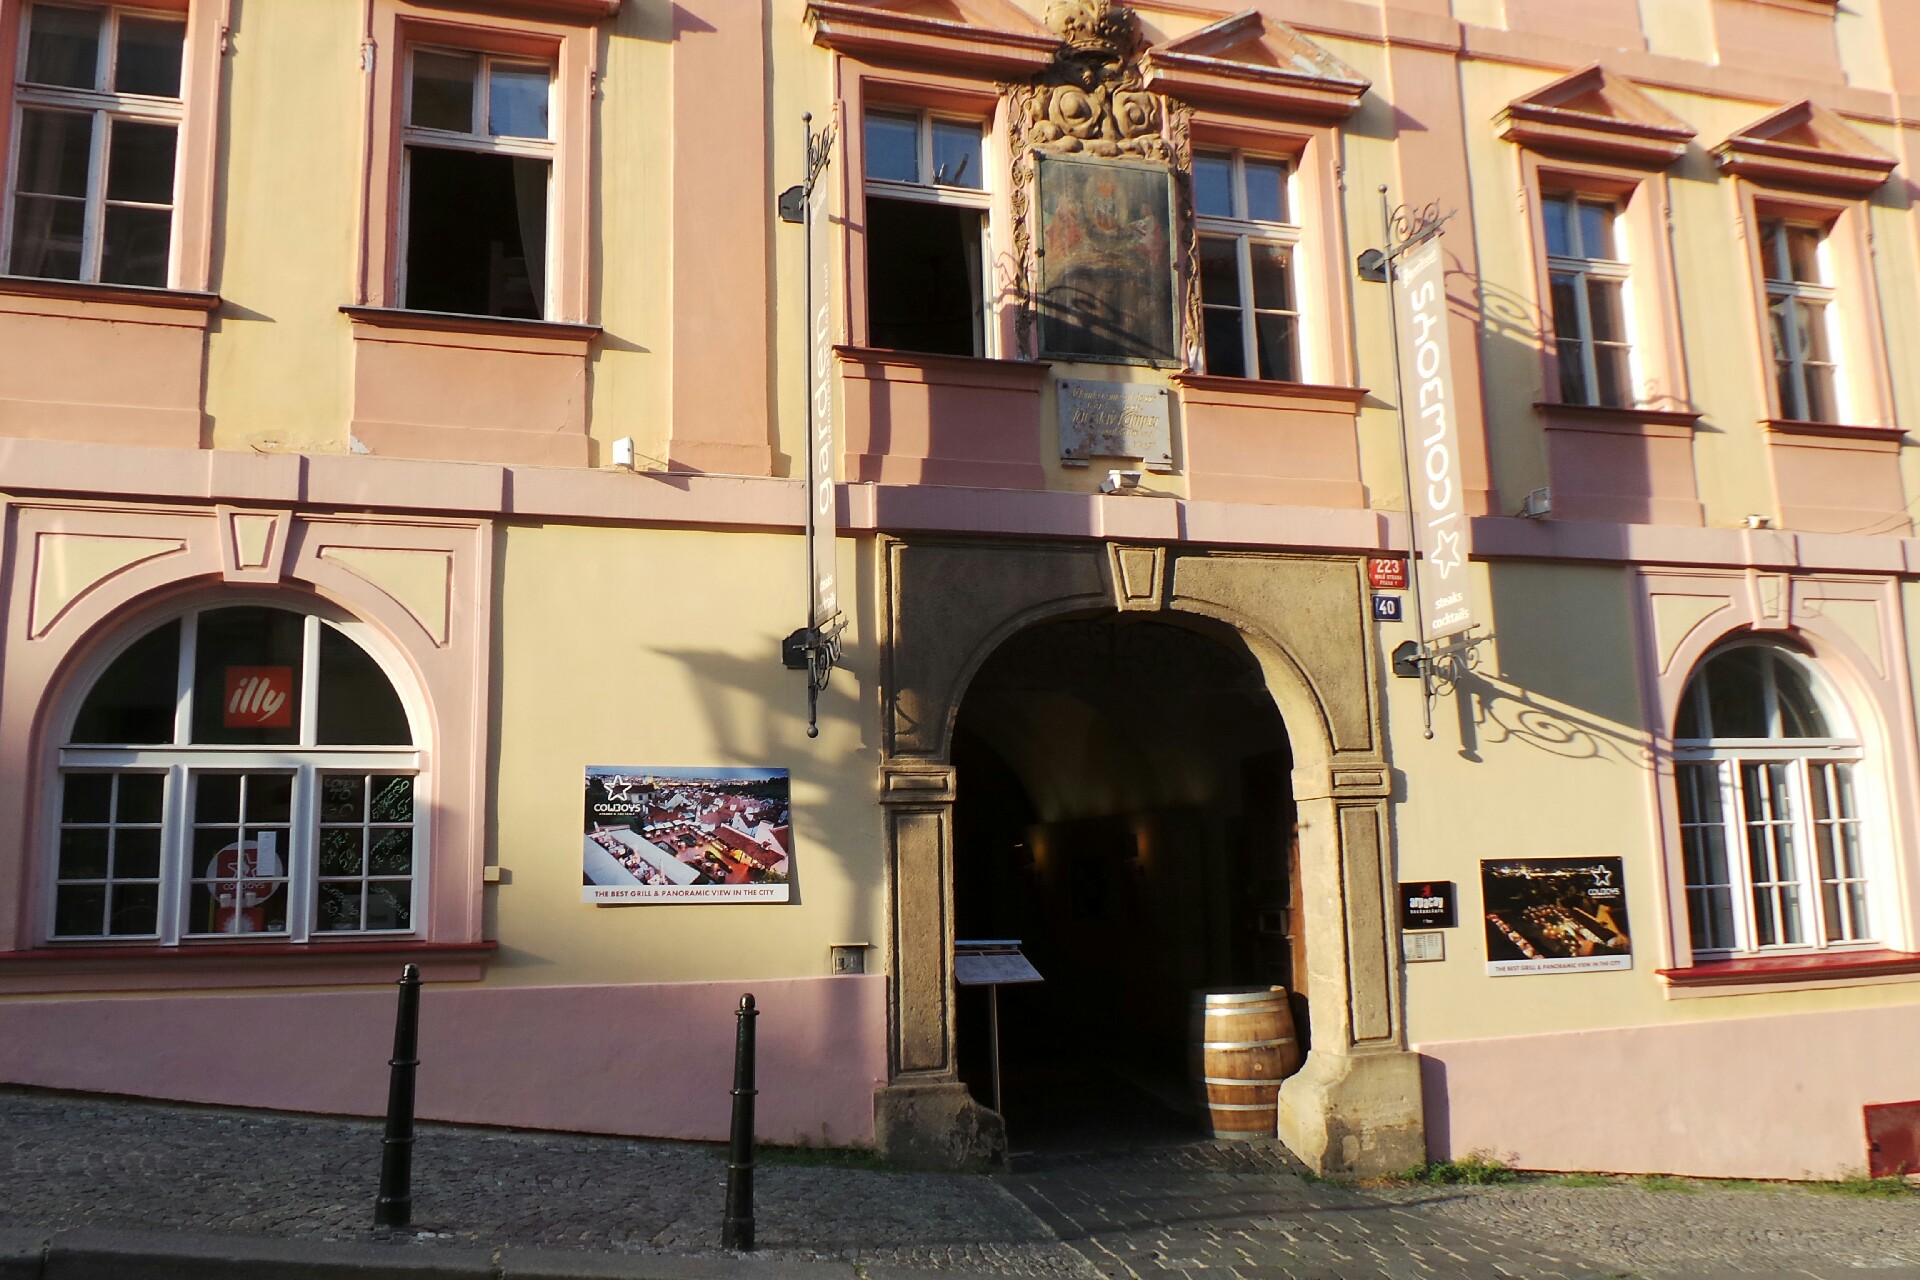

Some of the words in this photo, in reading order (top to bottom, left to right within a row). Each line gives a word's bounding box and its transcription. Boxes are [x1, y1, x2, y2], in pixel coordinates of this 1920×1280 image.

[815, 303, 833, 516] garden
[1375, 559, 1400, 574] 223
[1379, 600, 1395, 615] 40
[1435, 591, 1463, 610] steaks
[1432, 607, 1470, 629] cocktails
[229, 676, 286, 722] illy
[329, 789, 352, 801] TO
[594, 803, 641, 812] COWBOYS
[661, 889, 710, 897] PANORAMIC
